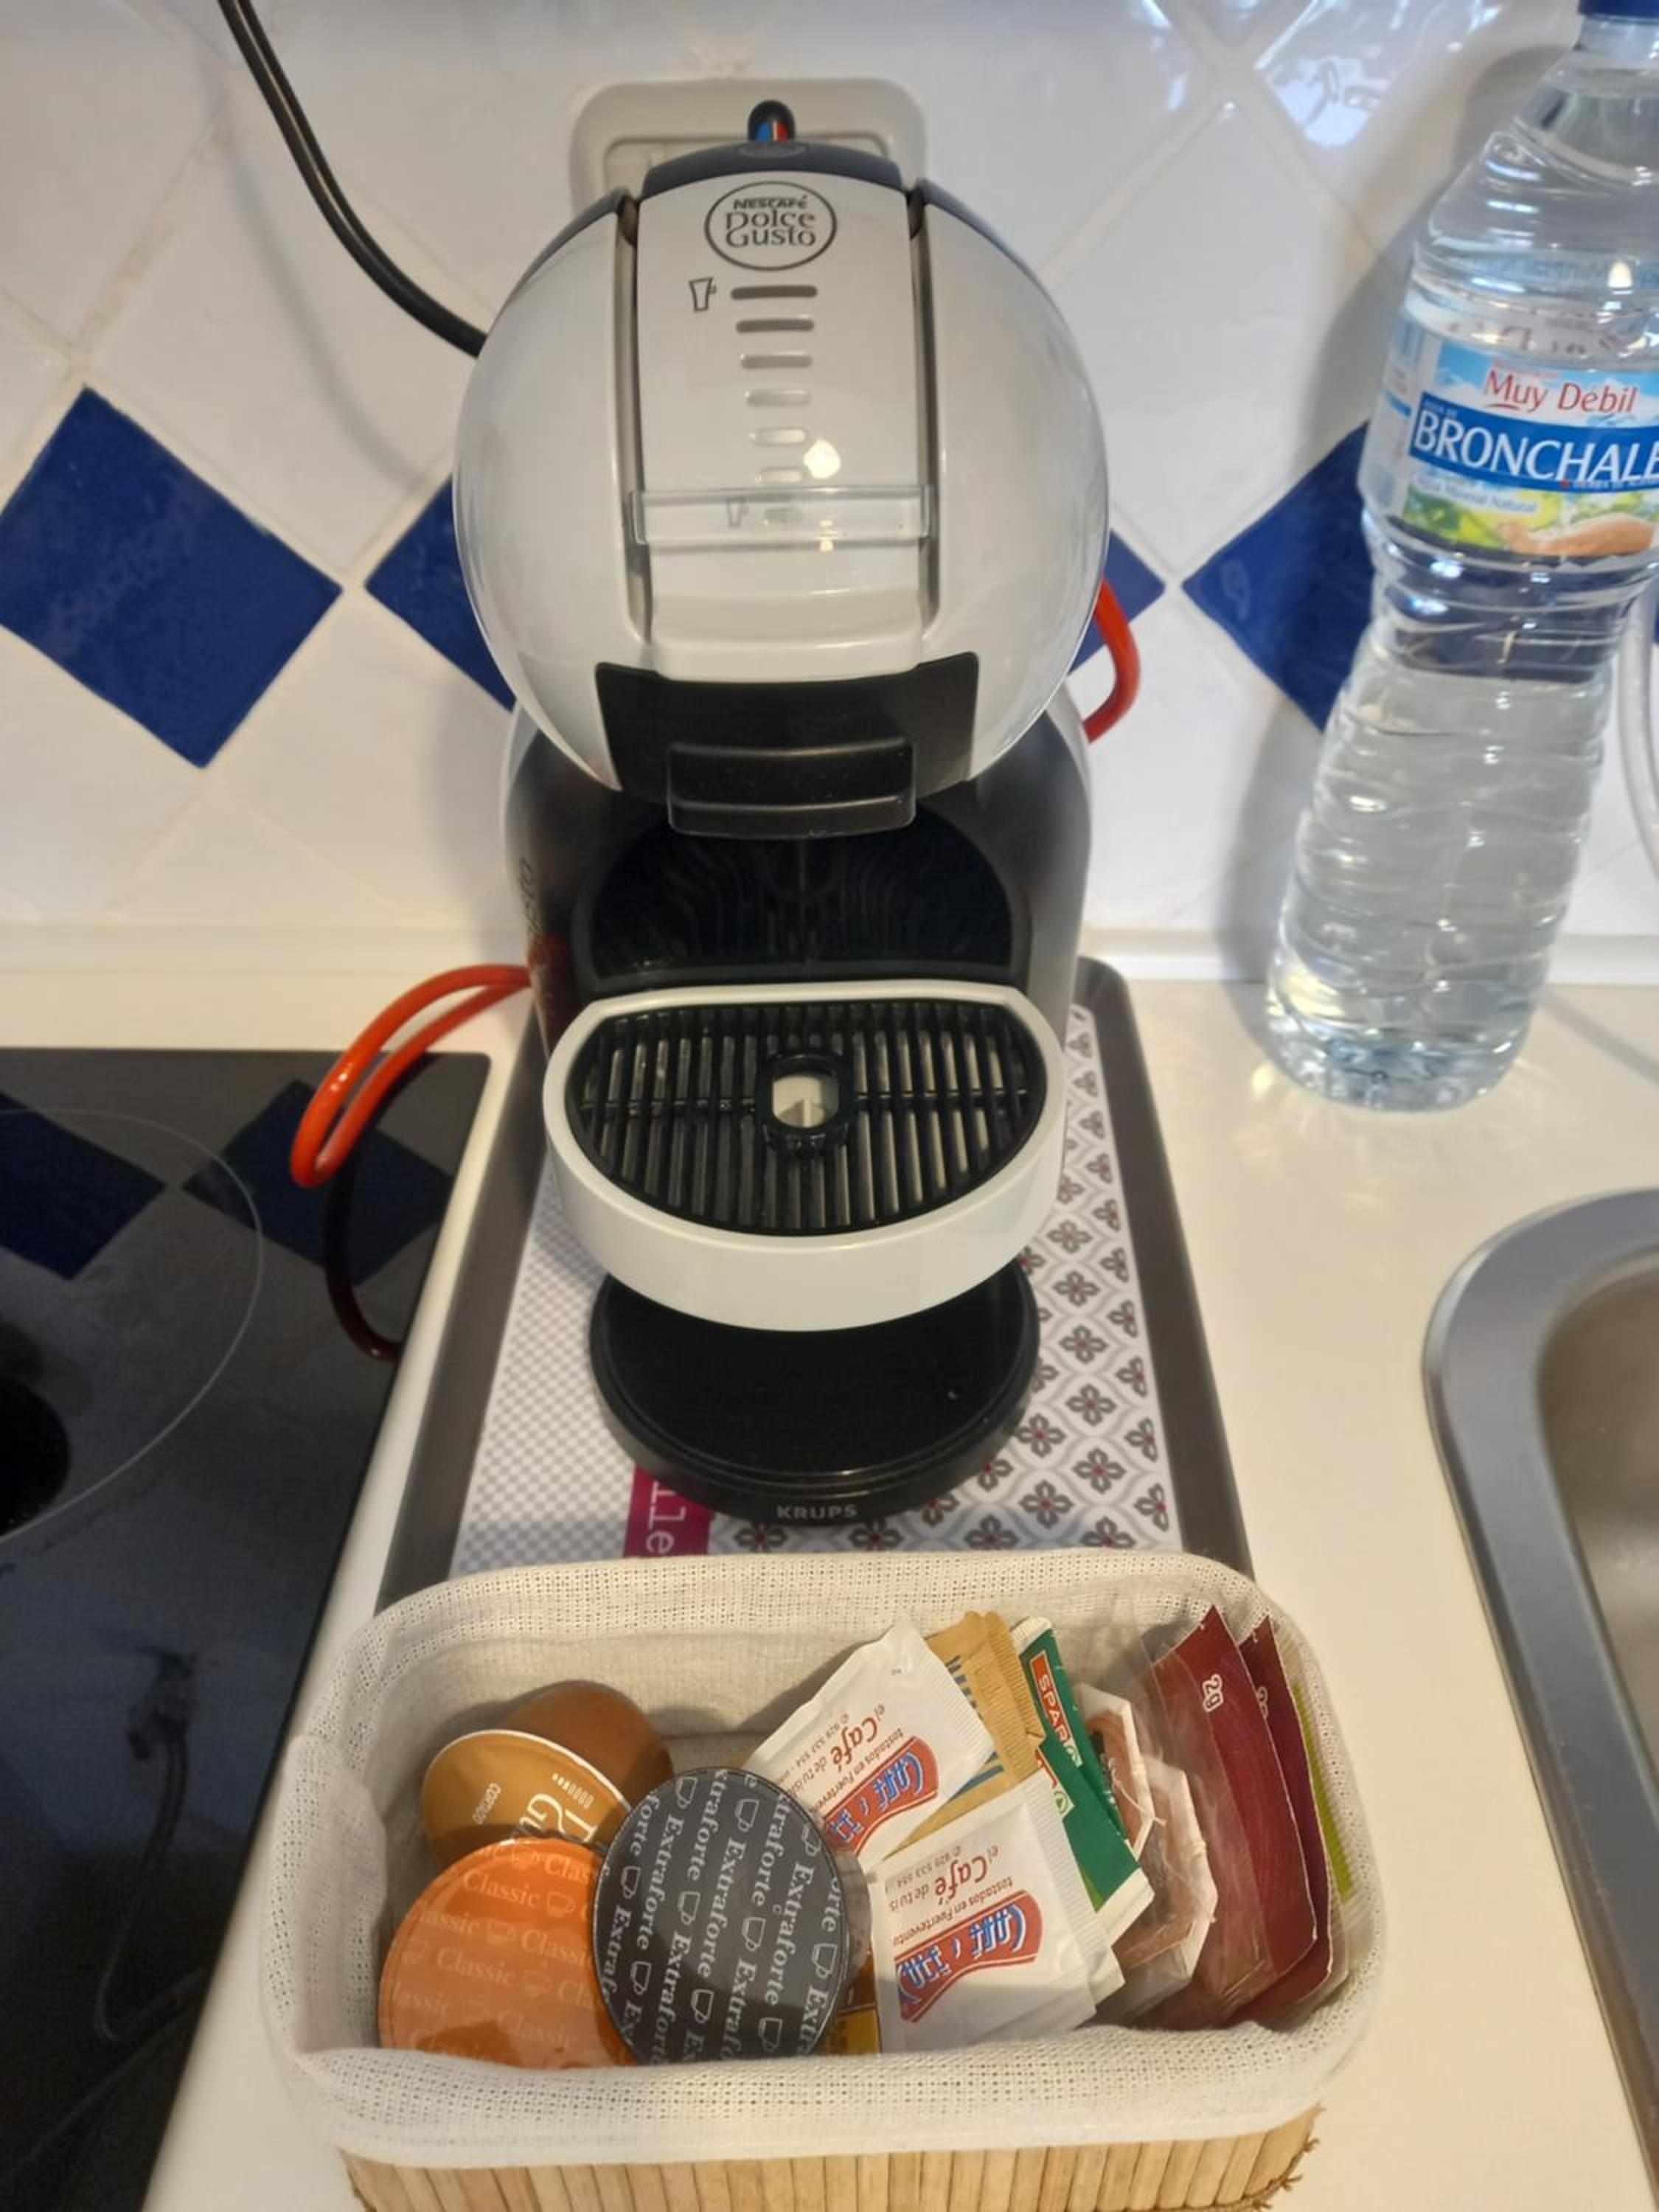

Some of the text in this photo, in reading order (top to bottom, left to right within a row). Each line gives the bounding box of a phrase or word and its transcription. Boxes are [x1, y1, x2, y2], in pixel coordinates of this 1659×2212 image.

[733, 195, 808, 210] NESCAFÉ
[1484, 369, 1548, 413] Muy
[776, 1504, 858, 1521] KRUPS
[830, 1717, 878, 1773] Café
[463, 1869, 540, 1907] Classic
[636, 1814, 684, 1950] Extraforte
[934, 1855, 987, 1906] Café
[698, 1837, 747, 1978] Extraforte
[765, 1861, 815, 2006] Extraforte
